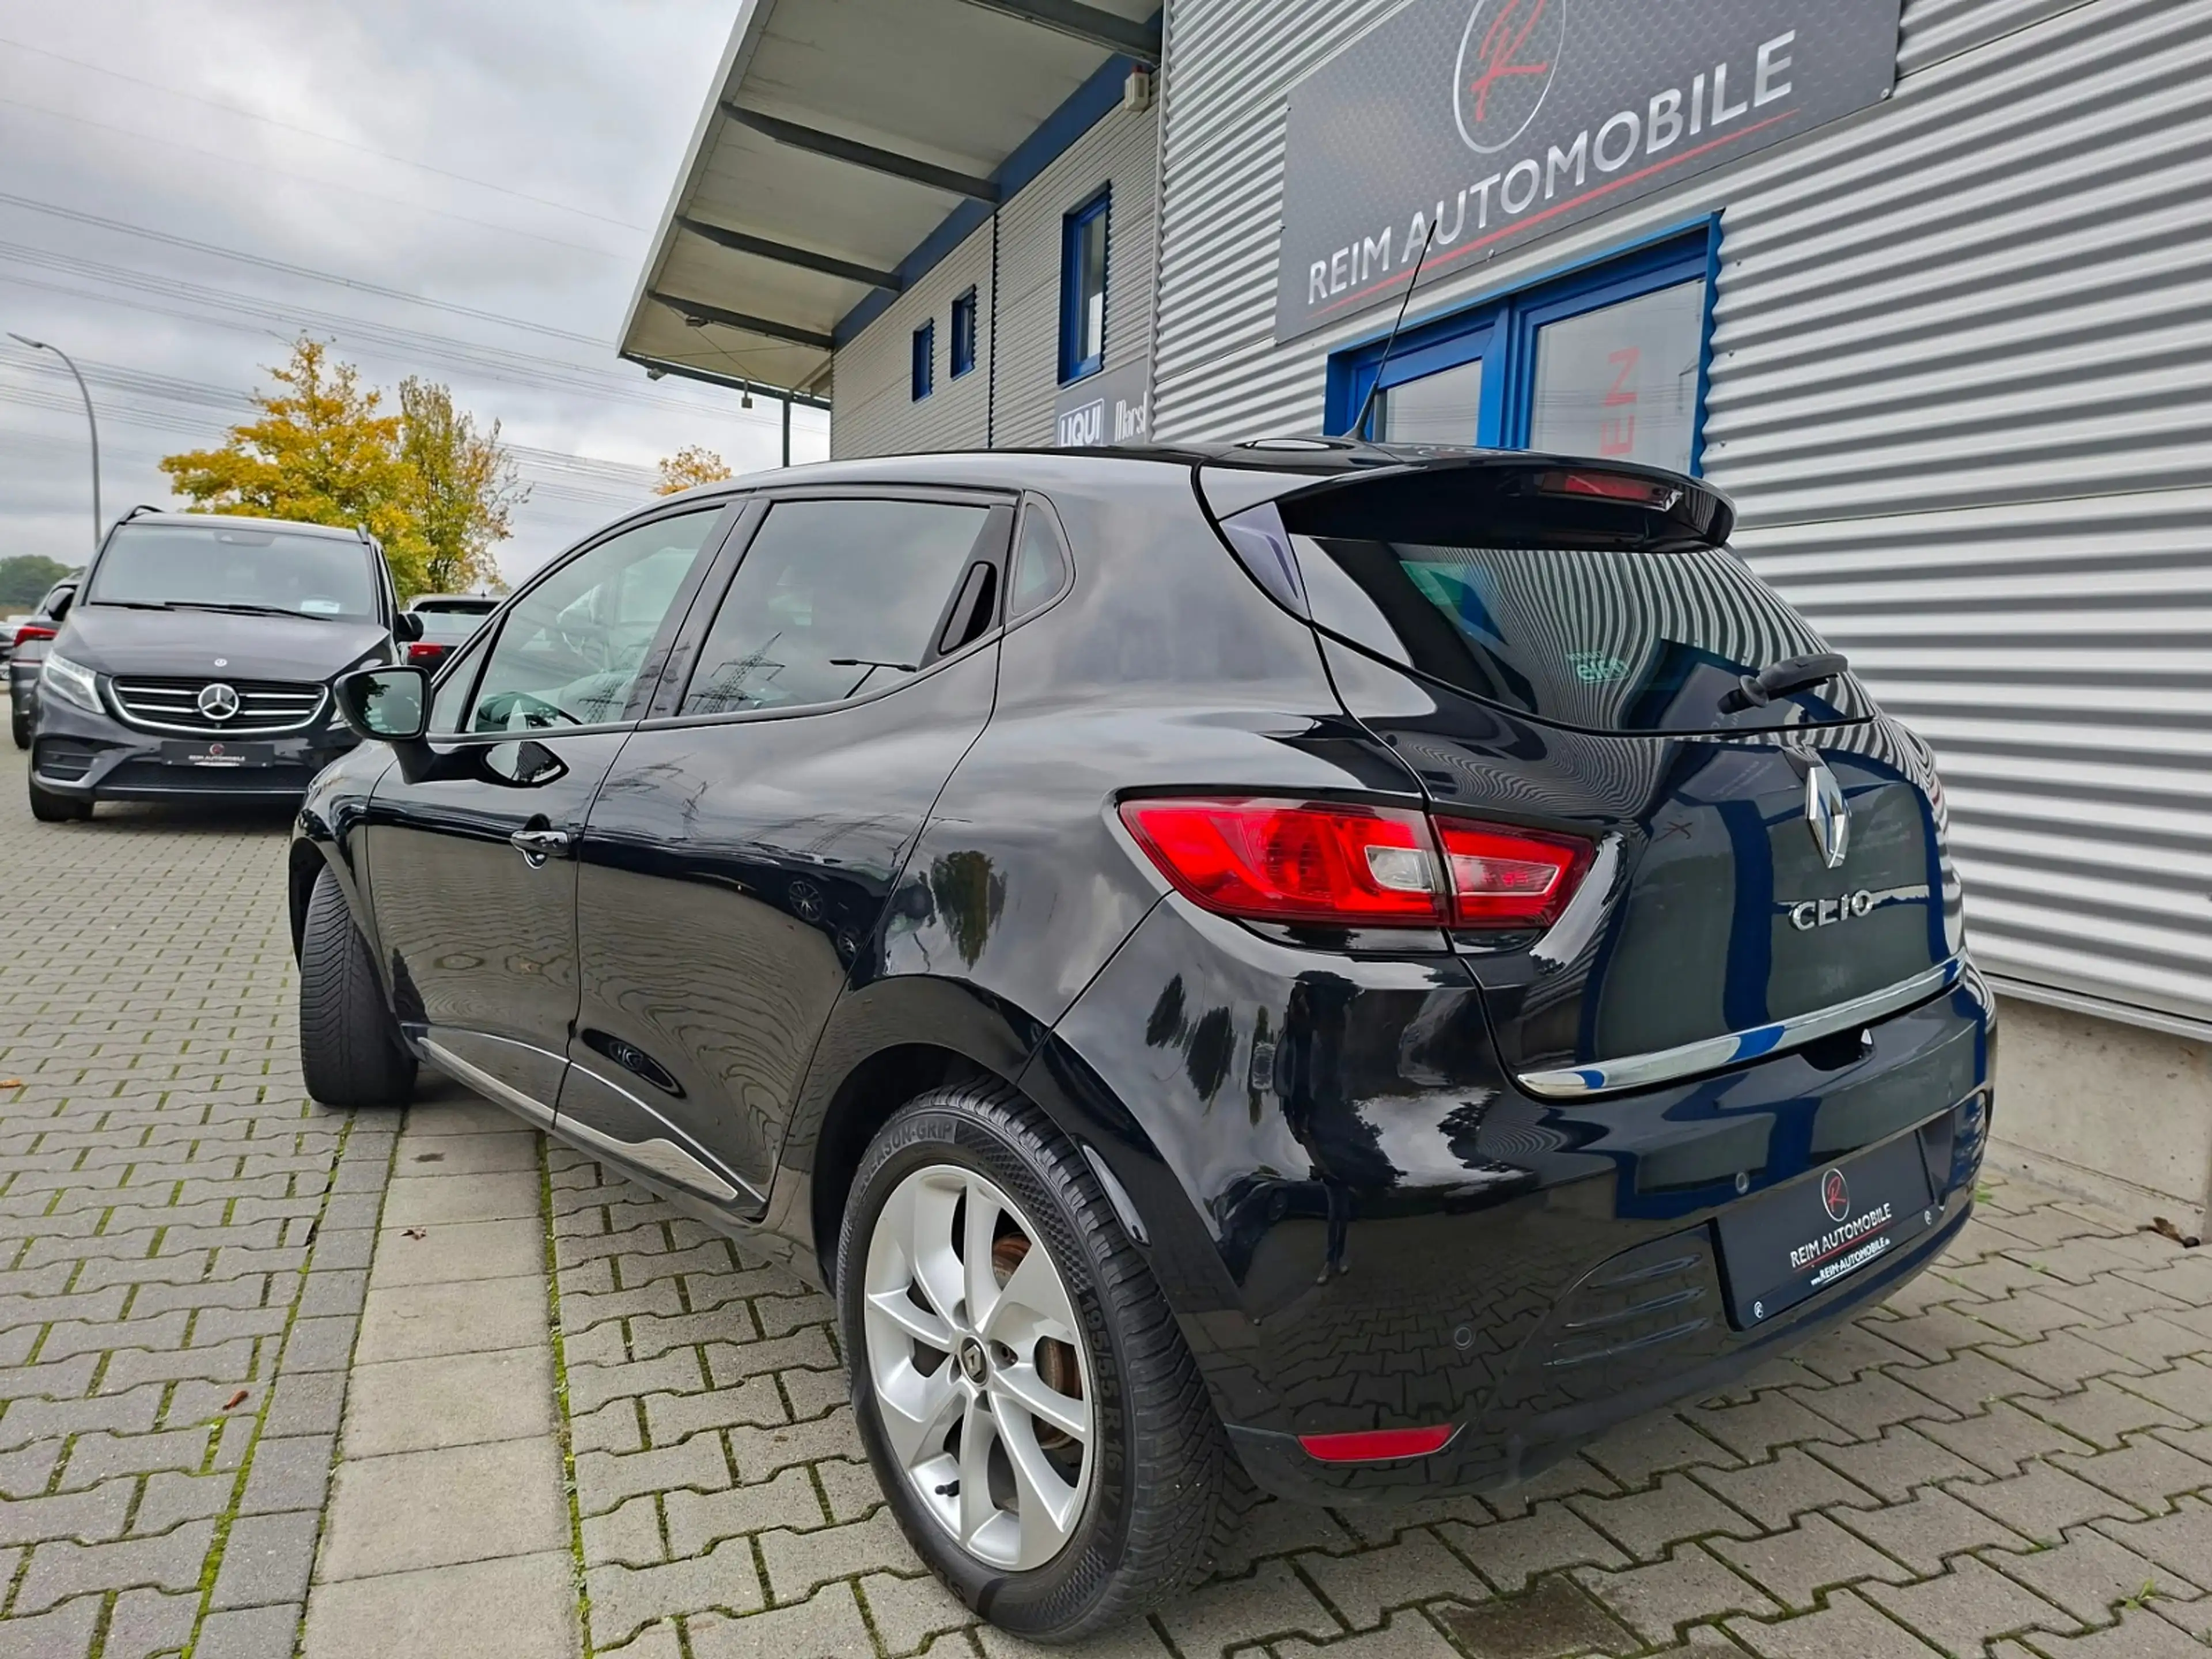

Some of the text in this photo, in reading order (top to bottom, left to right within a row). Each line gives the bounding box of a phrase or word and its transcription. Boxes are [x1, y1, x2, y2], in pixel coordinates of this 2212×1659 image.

[1308, 29, 1796, 305] REIM AUTOMOBILE
[1060, 404, 1101, 447] LIQUI
[1114, 391, 1147, 442] Mars
[1788, 889, 1874, 931] CLIO
[1790, 1202, 1892, 1268] REIM AUTOMOBILE
